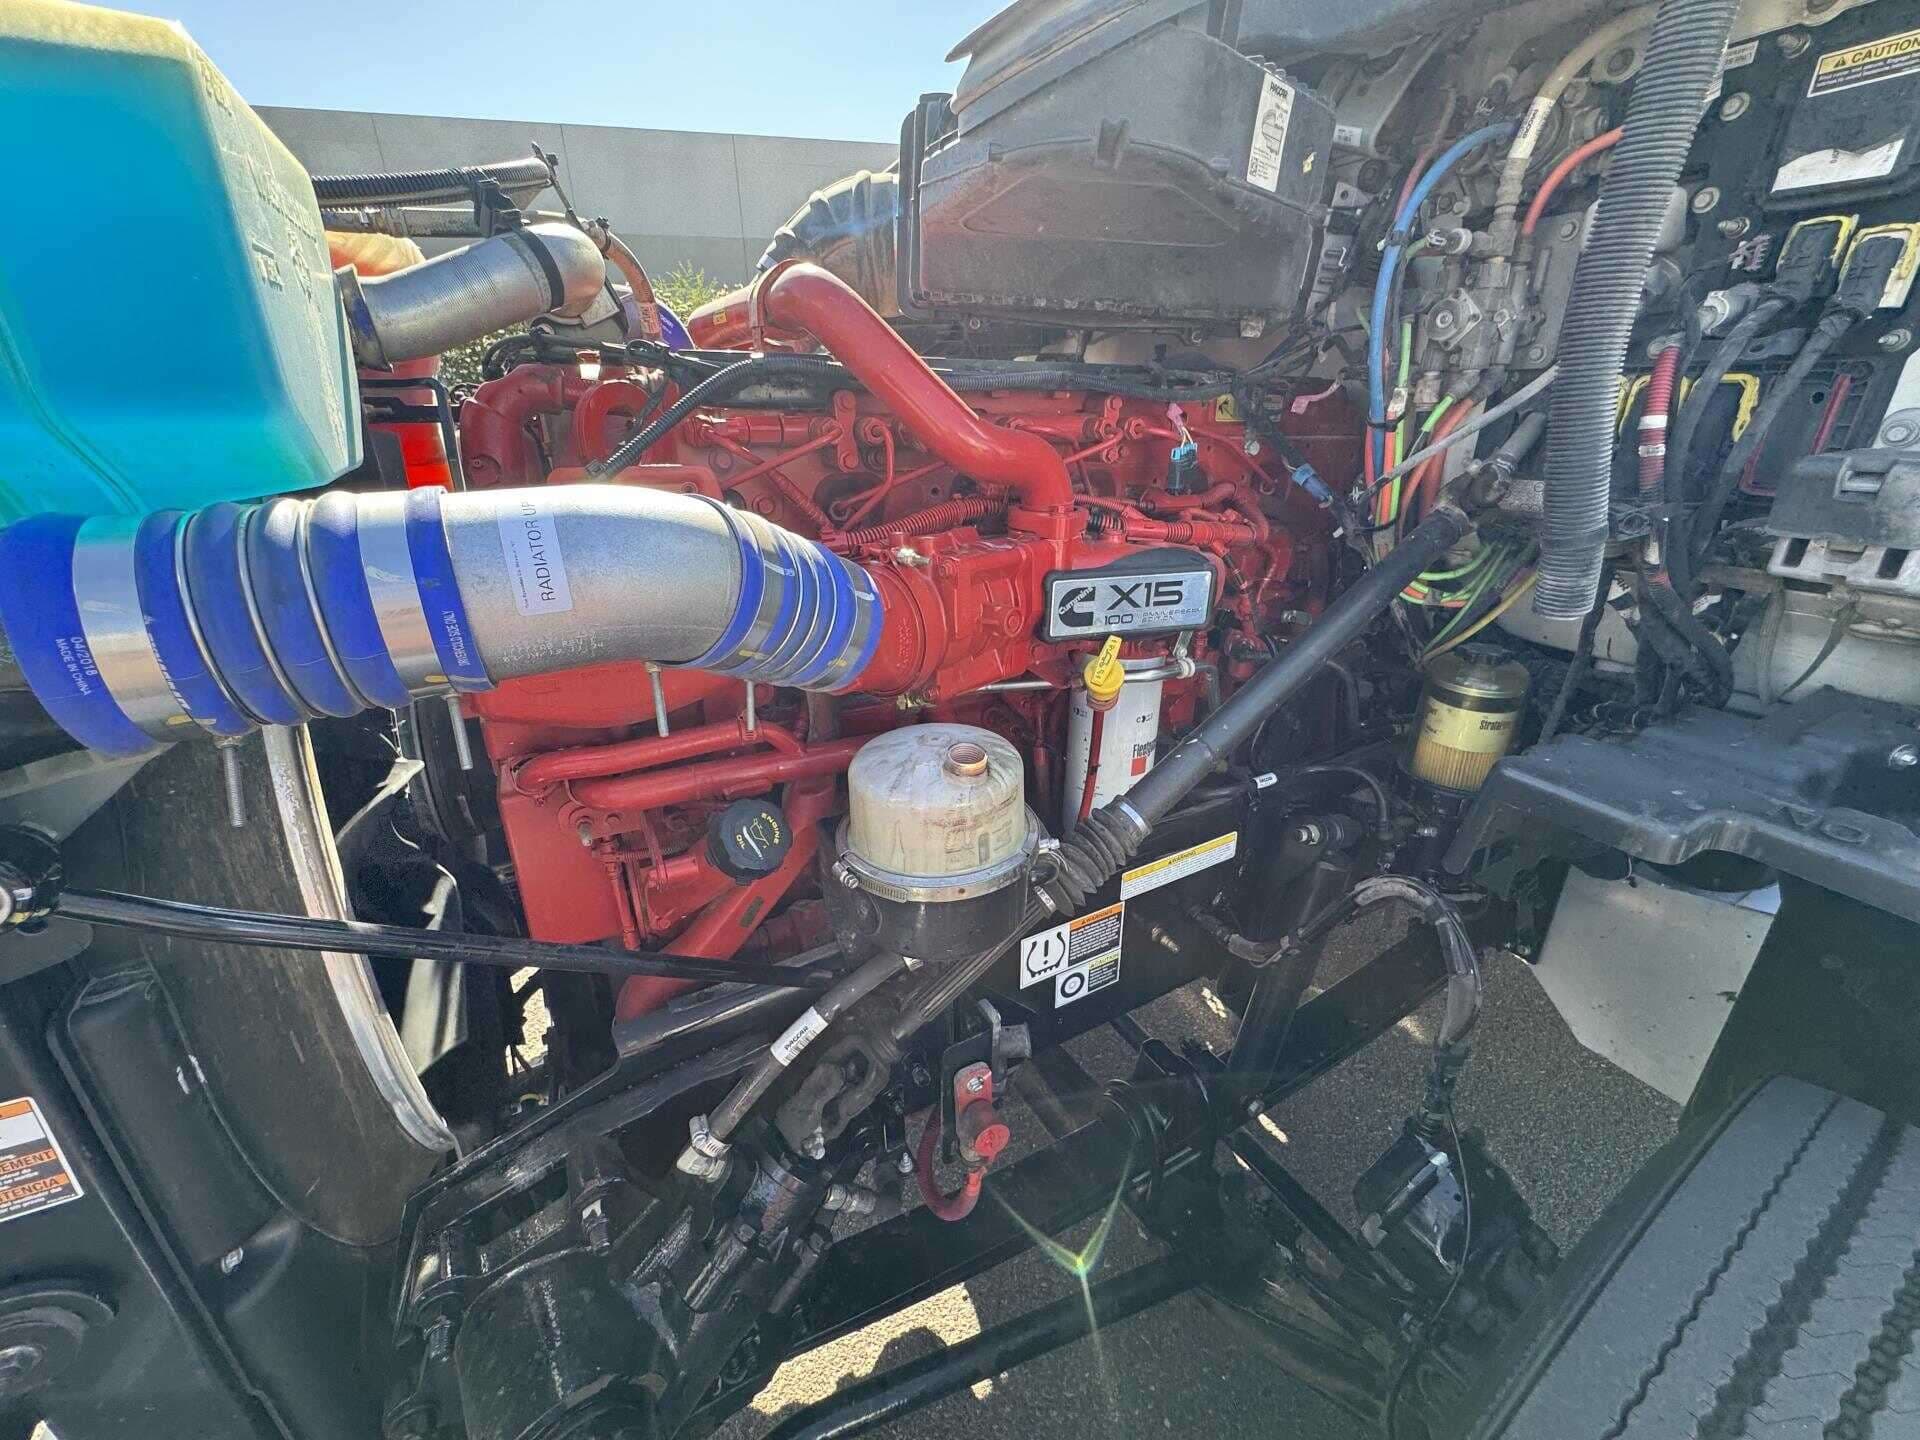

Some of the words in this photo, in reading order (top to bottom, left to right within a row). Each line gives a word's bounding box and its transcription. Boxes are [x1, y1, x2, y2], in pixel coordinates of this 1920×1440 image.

[1852, 37, 1920, 64] CAUTION
[525, 520, 556, 601] RADIATOR
[1058, 586, 1095, 615] Cummins
[1106, 580, 1183, 610] X15
[1104, 613, 1134, 625] 100
[56, 638, 75, 663] MADE
[72, 672, 92, 696] CHINA
[70, 636, 98, 676] 04/2018
[736, 834, 746, 850] OIL
[761, 812, 781, 845] ENGINE
[784, 1026, 808, 1050] PACCAR
